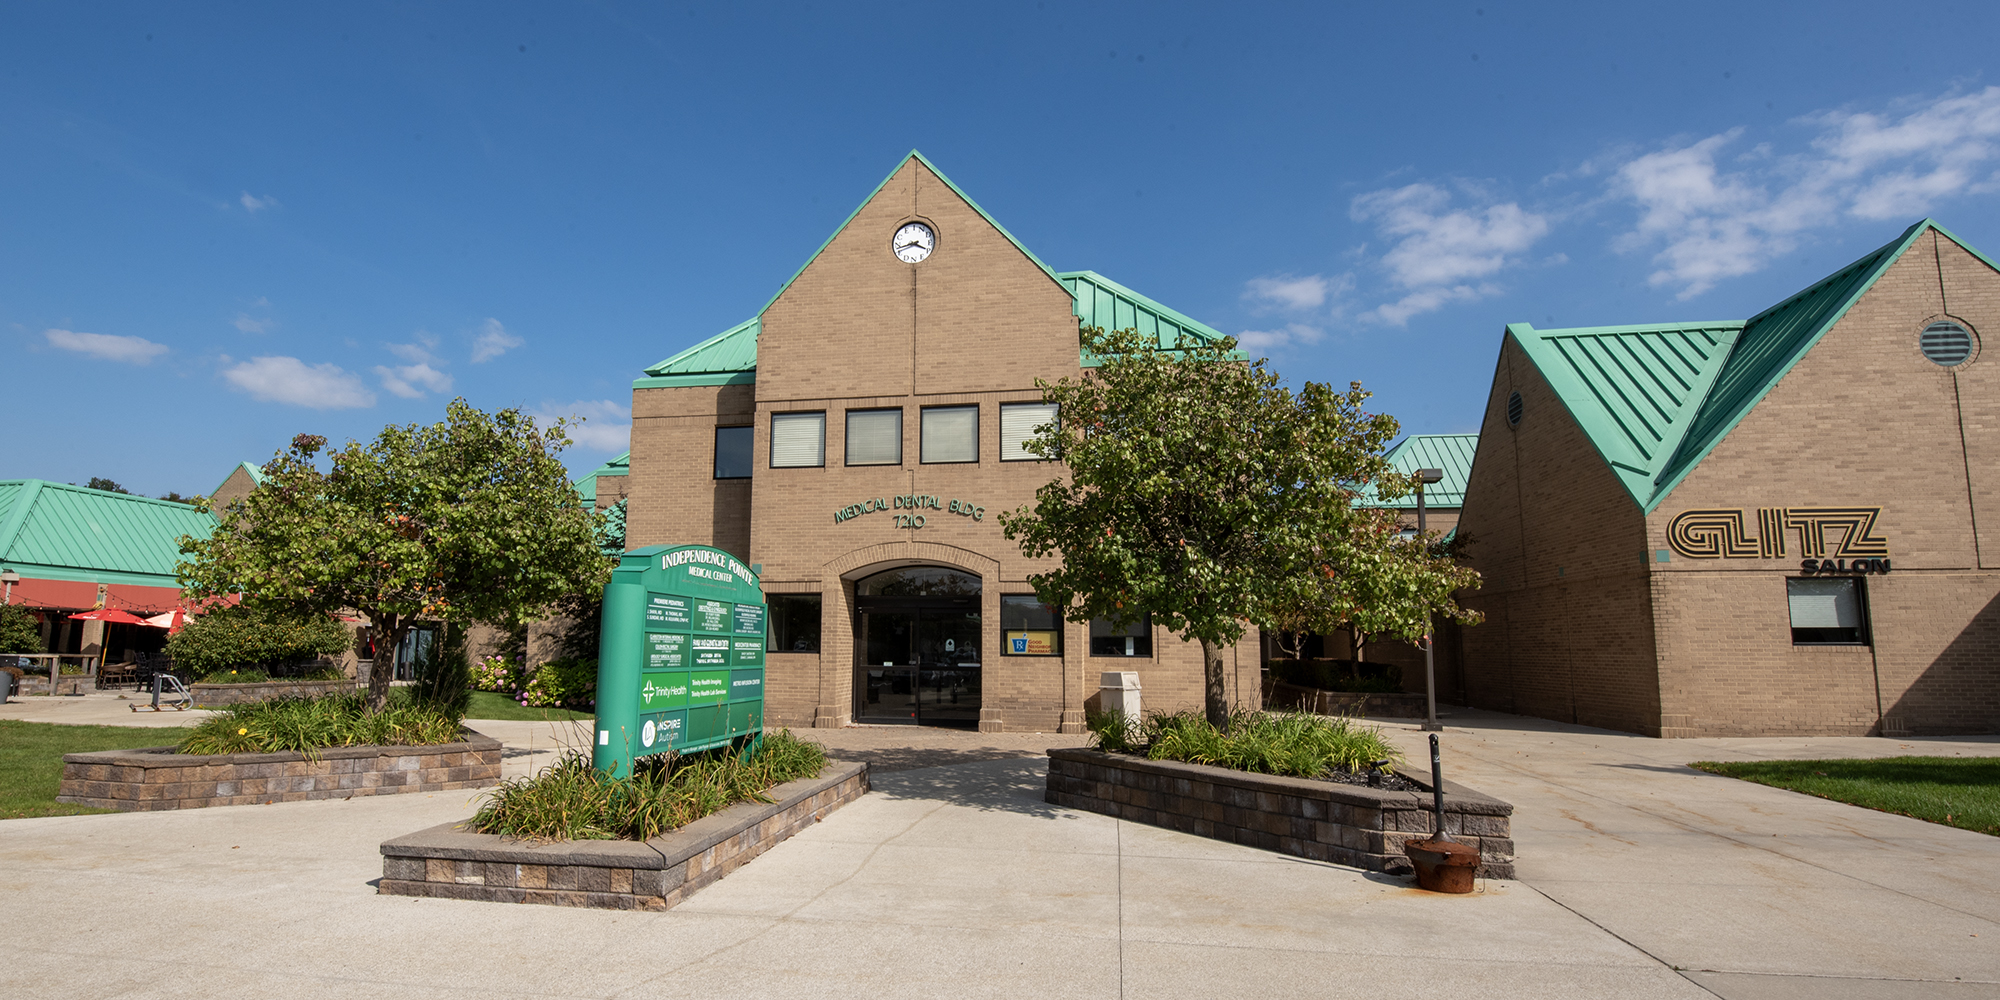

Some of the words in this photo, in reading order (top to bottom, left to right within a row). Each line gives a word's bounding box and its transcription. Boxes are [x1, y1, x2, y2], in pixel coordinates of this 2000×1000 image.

[834, 497, 890, 525] MEDICAL
[894, 494, 943, 510] DENTAL
[948, 498, 986, 523] BLDG
[892, 514, 927, 530] 7210
[1667, 505, 1890, 558] GLITZ
[661, 549, 726, 570] INDEPENDENCE
[728, 559, 753, 587] POINTE
[688, 566, 712, 580] MEDICAL
[713, 570, 733, 583] CENTER
[1802, 558, 1892, 575] SALON
[655, 686, 670, 698] Trinity
[671, 686, 687, 696] Health
[658, 732, 678, 742] Autism
